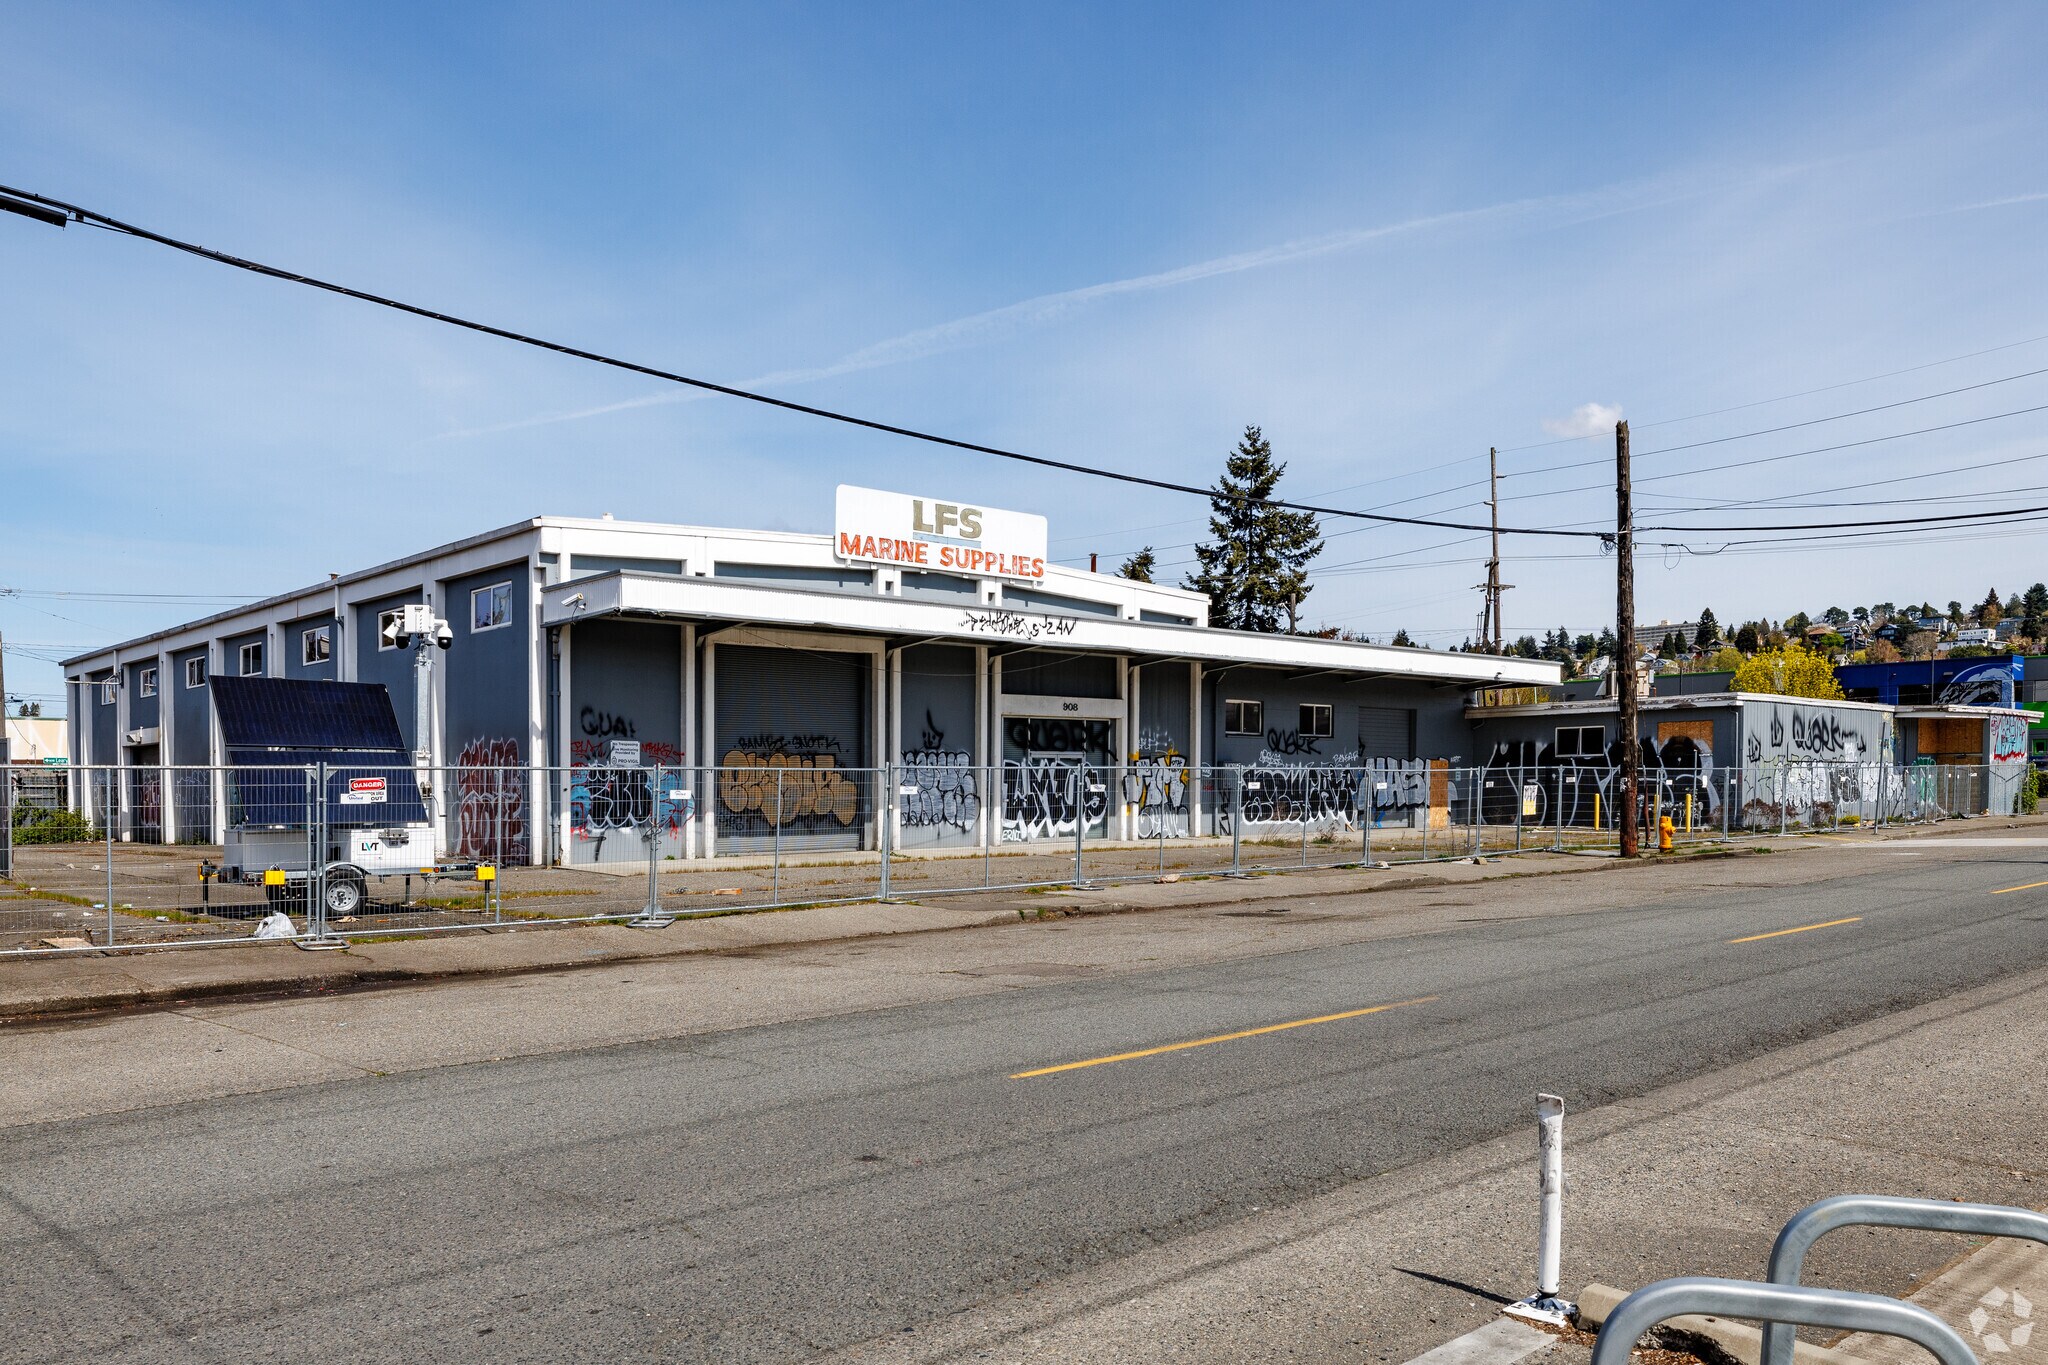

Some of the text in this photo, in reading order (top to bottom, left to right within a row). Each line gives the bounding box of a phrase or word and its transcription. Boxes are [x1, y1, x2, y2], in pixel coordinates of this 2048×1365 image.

[913, 500, 982, 539] LFS
[840, 532, 1044, 578] MARINE SUPPLIES
[1063, 703, 1078, 711] 908
[361, 842, 379, 851] LVT
